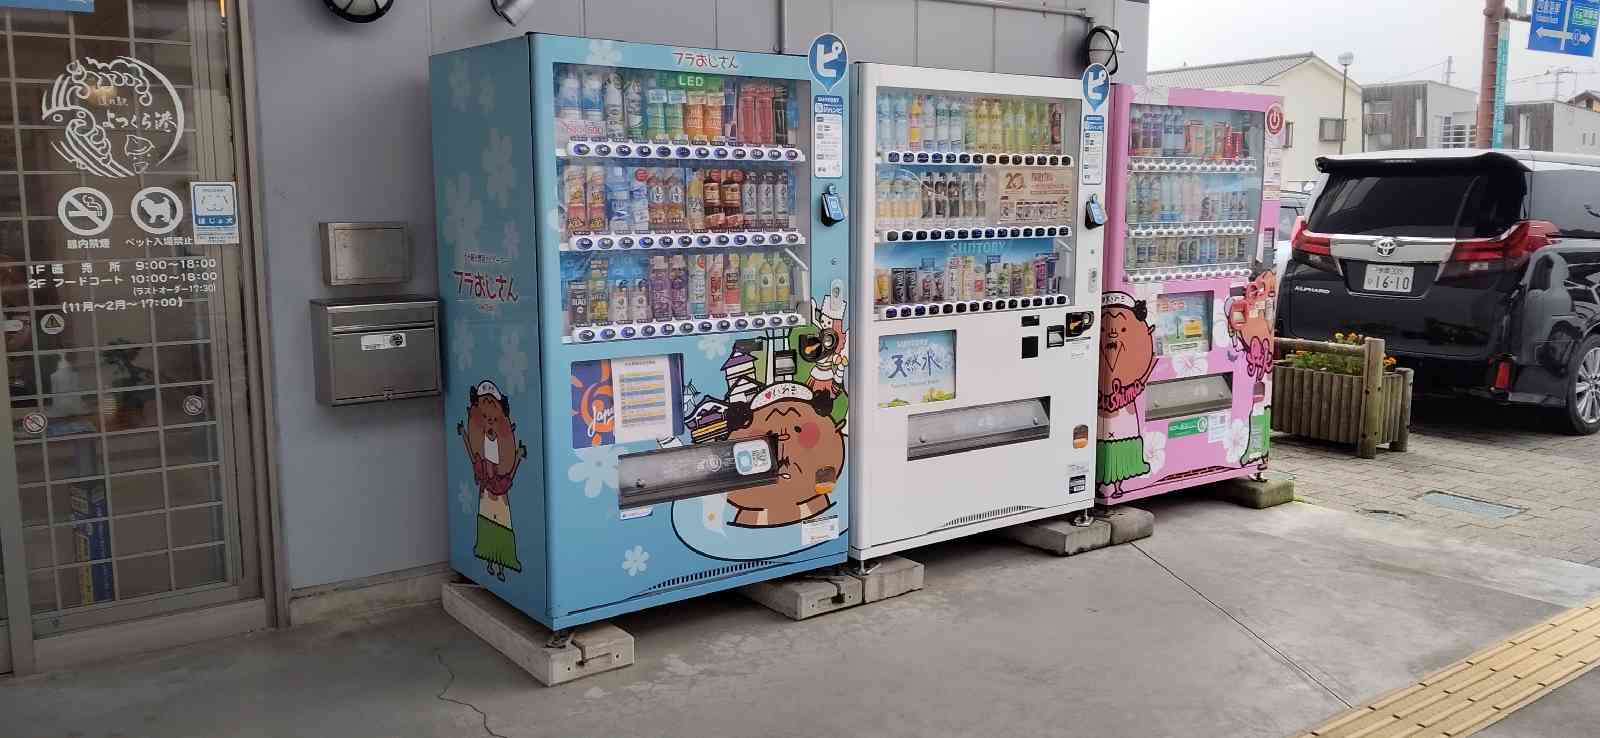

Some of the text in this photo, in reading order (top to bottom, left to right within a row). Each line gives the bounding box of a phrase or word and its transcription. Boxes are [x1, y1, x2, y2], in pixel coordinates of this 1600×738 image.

[672, 51, 739, 69] フラおじさん
[678, 73, 705, 87] LED
[102, 109, 177, 133] よつくら港
[66, 238, 111, 249] 館内禁煙
[125, 236, 193, 248] ペット入場禁止
[951, 240, 1007, 256] SUNTORY
[29, 264, 45, 275] 1F
[28, 278, 48, 289] 2F
[52, 275, 124, 288] フードコート
[453, 270, 520, 304] フラおじさん
[887, 350, 944, 379] 天然水
